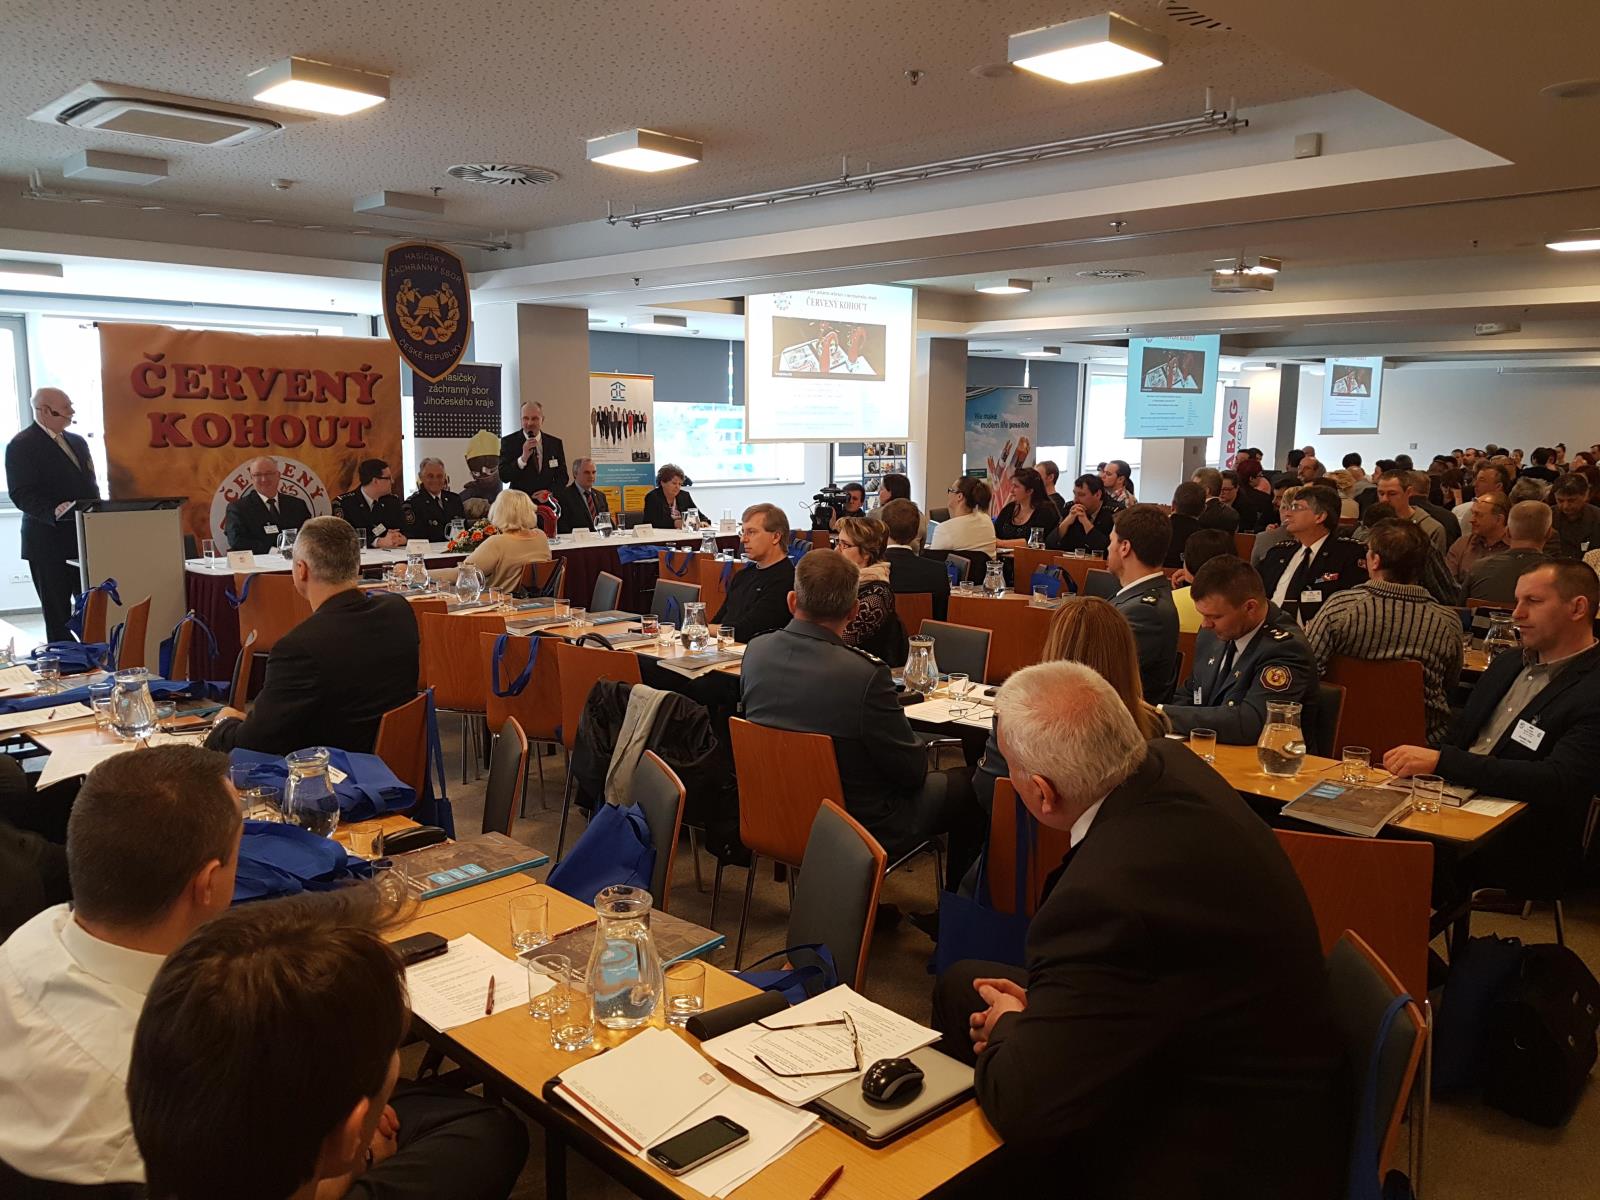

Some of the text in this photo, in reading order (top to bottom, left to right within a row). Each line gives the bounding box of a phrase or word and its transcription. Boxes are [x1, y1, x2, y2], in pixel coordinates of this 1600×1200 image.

[130, 352, 383, 405] ČERVENÝ
[428, 383, 489, 396] záchranný sbor
[424, 396, 494, 408] Jihočeského kraje
[147, 411, 373, 449] KOHOUT
